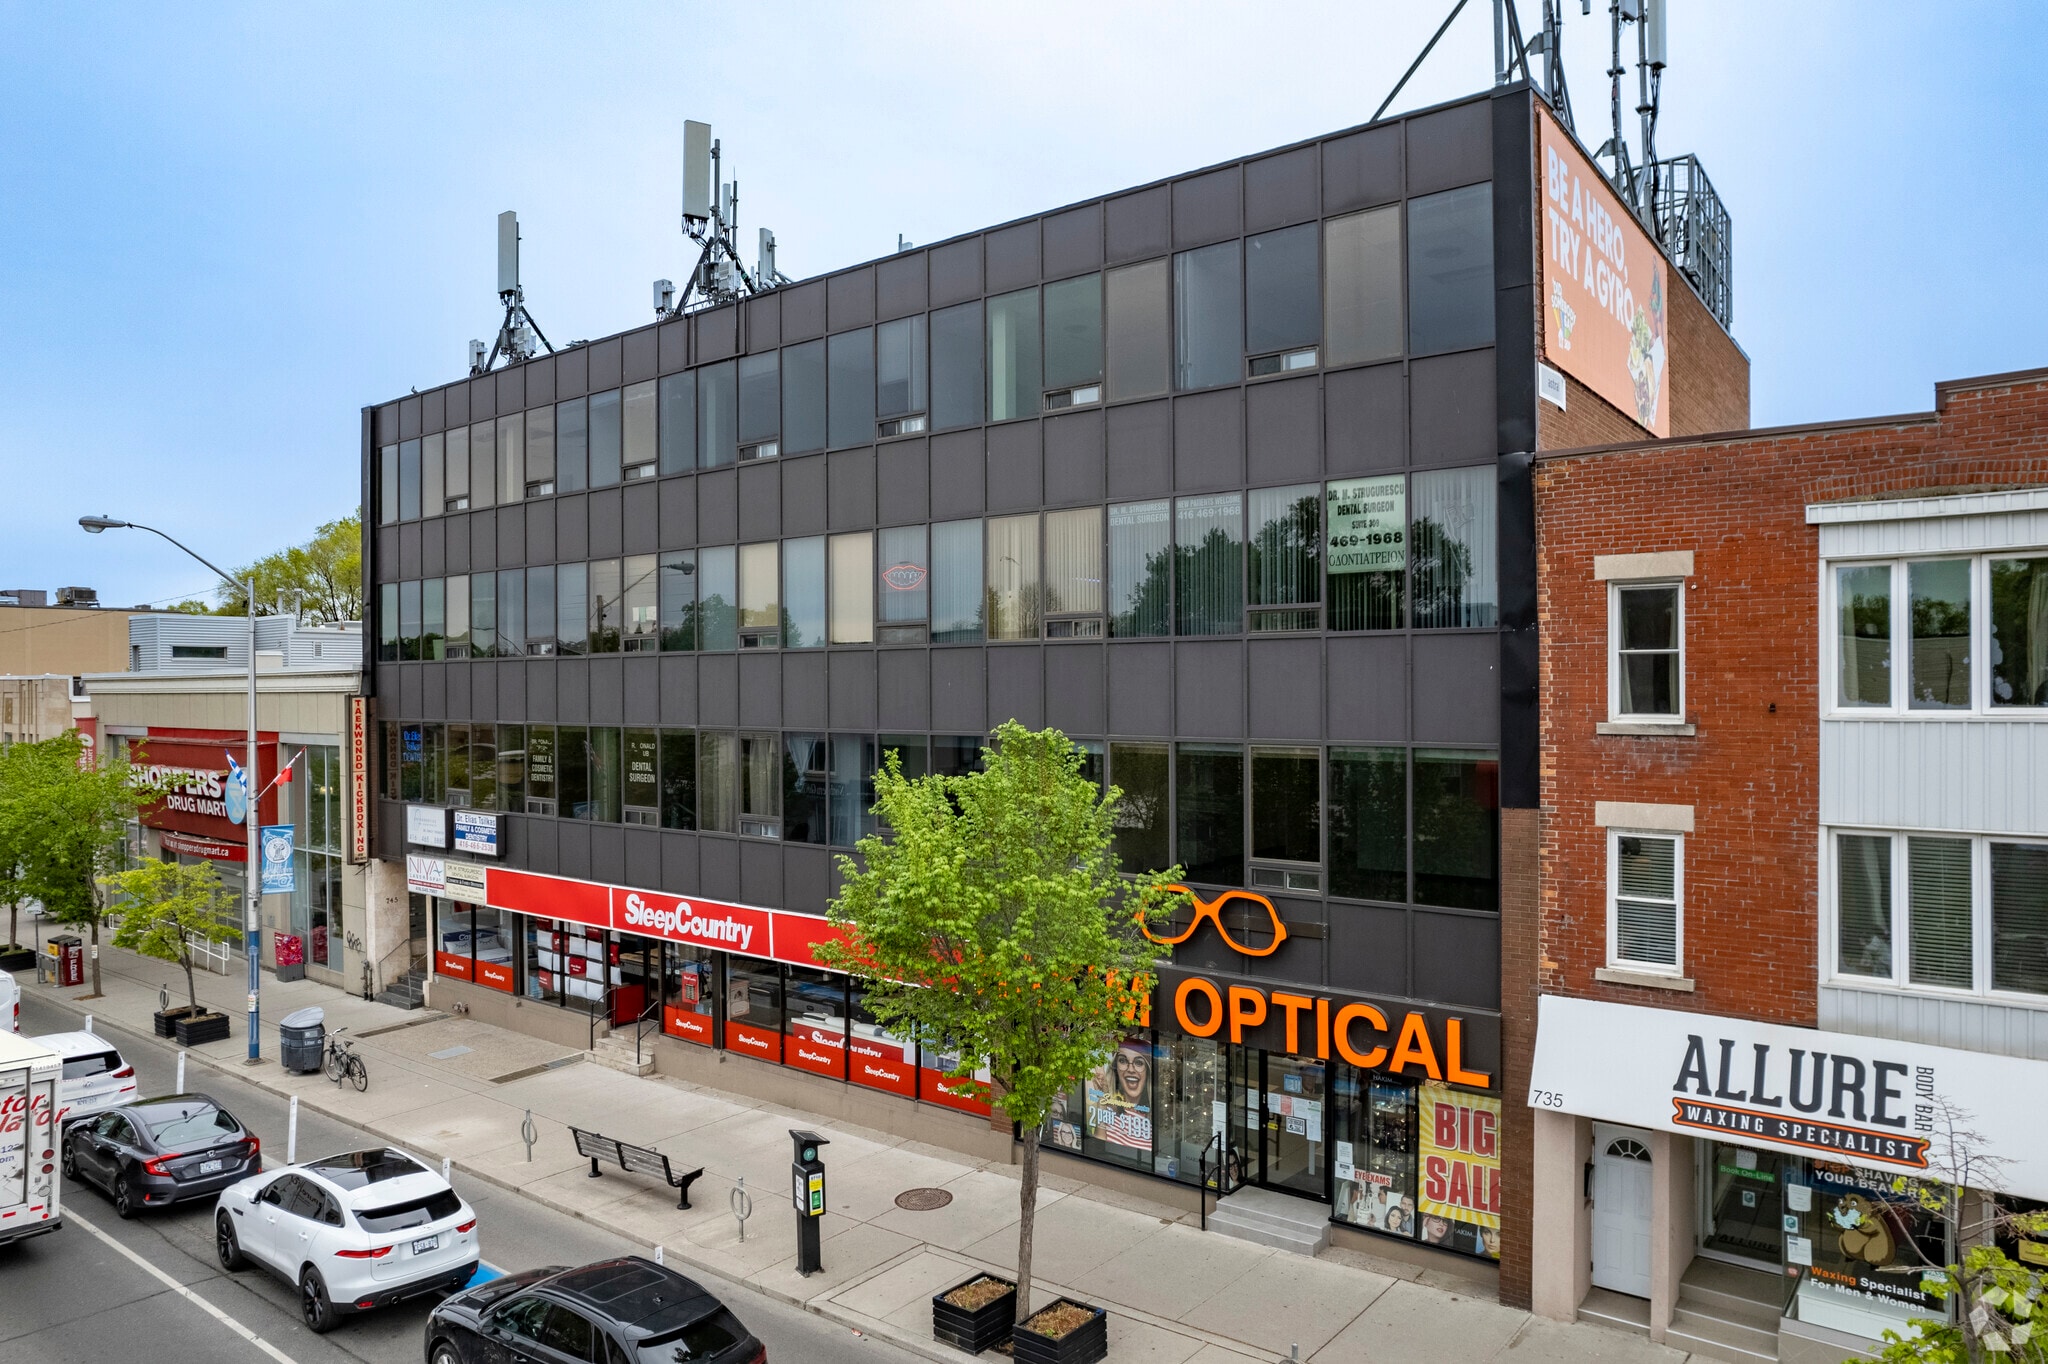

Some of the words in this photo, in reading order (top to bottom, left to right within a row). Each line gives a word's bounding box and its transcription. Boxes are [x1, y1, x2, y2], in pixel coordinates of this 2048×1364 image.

[1548, 144, 1568, 214] BE
[1572, 176, 1584, 231] A
[1586, 189, 1628, 284] HERO,
[1549, 206, 1581, 281] TRY
[1583, 245, 1595, 298] A
[1597, 259, 1635, 333] GYRO
[1328, 490, 1339, 501] DR.
[1342, 488, 1350, 500] M.
[1352, 483, 1405, 499] STRUGURESCU
[1177, 500, 1189, 508] NEW
[1190, 498, 1214, 508] PATIENTS
[1215, 495, 1240, 505] WELCOME
[1338, 503, 1361, 516] DENTAL
[1363, 500, 1395, 514] SURGEON
[1110, 506, 1120, 515] DR.
[1178, 510, 1194, 520] 416
[1110, 515, 1135, 526] DENTAL
[1137, 513, 1169, 524] SURGEON
[1330, 532, 1403, 548] 469-1968
[354, 699, 363, 769] TAEKWONDO
[532, 755, 547, 763] FAMILY
[631, 762, 652, 772] DENTAL
[532, 764, 553, 773] COSMETIC
[531, 773, 554, 782] DENTISTRY
[629, 773, 655, 783] SURGEON
[167, 795, 196, 813] DRUG
[196, 798, 227, 817] MART
[355, 774, 365, 852] KICKBOXING
[456, 814, 464, 822] Dr.
[465, 814, 477, 823] Elias
[478, 816, 496, 826] Tsilkas
[456, 824, 470, 832] FAMILY
[474, 826, 496, 835] COSMETIC
[625, 893, 753, 950] SleepCountry
[675, 1018, 703, 1033] SleepCountry
[1174, 977, 1491, 1088] OPTICAL
[738, 1034, 769, 1049] SleepCountry
[798, 1049, 831, 1065] SleepCountry
[864, 1065, 900, 1082] SleepCountry
[1673, 1034, 1909, 1128] ALLURE
[1915, 1066, 1934, 1101] BODY
[1534, 1089, 1563, 1108] 735
[1088, 1105, 1097, 1127] 2
[1097, 1107, 1116, 1125] pair
[1119, 1113, 1151, 1140] $199
[1914, 1104, 1933, 1131] BAR
[1433, 1101, 1498, 1159] BIG
[1687, 1105, 1764, 1133] WAXING
[1779, 1122, 1913, 1159] SPECIALIST
[1354, 1170, 1367, 1182] EYE
[1366, 1172, 1391, 1186] EXAMS
[1720, 1165, 1740, 1175] Book
[1741, 1170, 1774, 1181] On-Line
[1814, 1159, 1850, 1173] STOP
[1855, 1167, 1919, 1188] SHAVIG
[1815, 1170, 1854, 1186] YOUR
[1425, 1155, 1500, 1216] SALE
[1811, 1266, 1857, 1286] Waxing
[1860, 1277, 1926, 1301] Specialist
[1810, 1278, 1831, 1290] For
[1835, 1284, 1861, 1298] Men
[1865, 1292, 1874, 1301] &
[1877, 1293, 1926, 1313] Women
